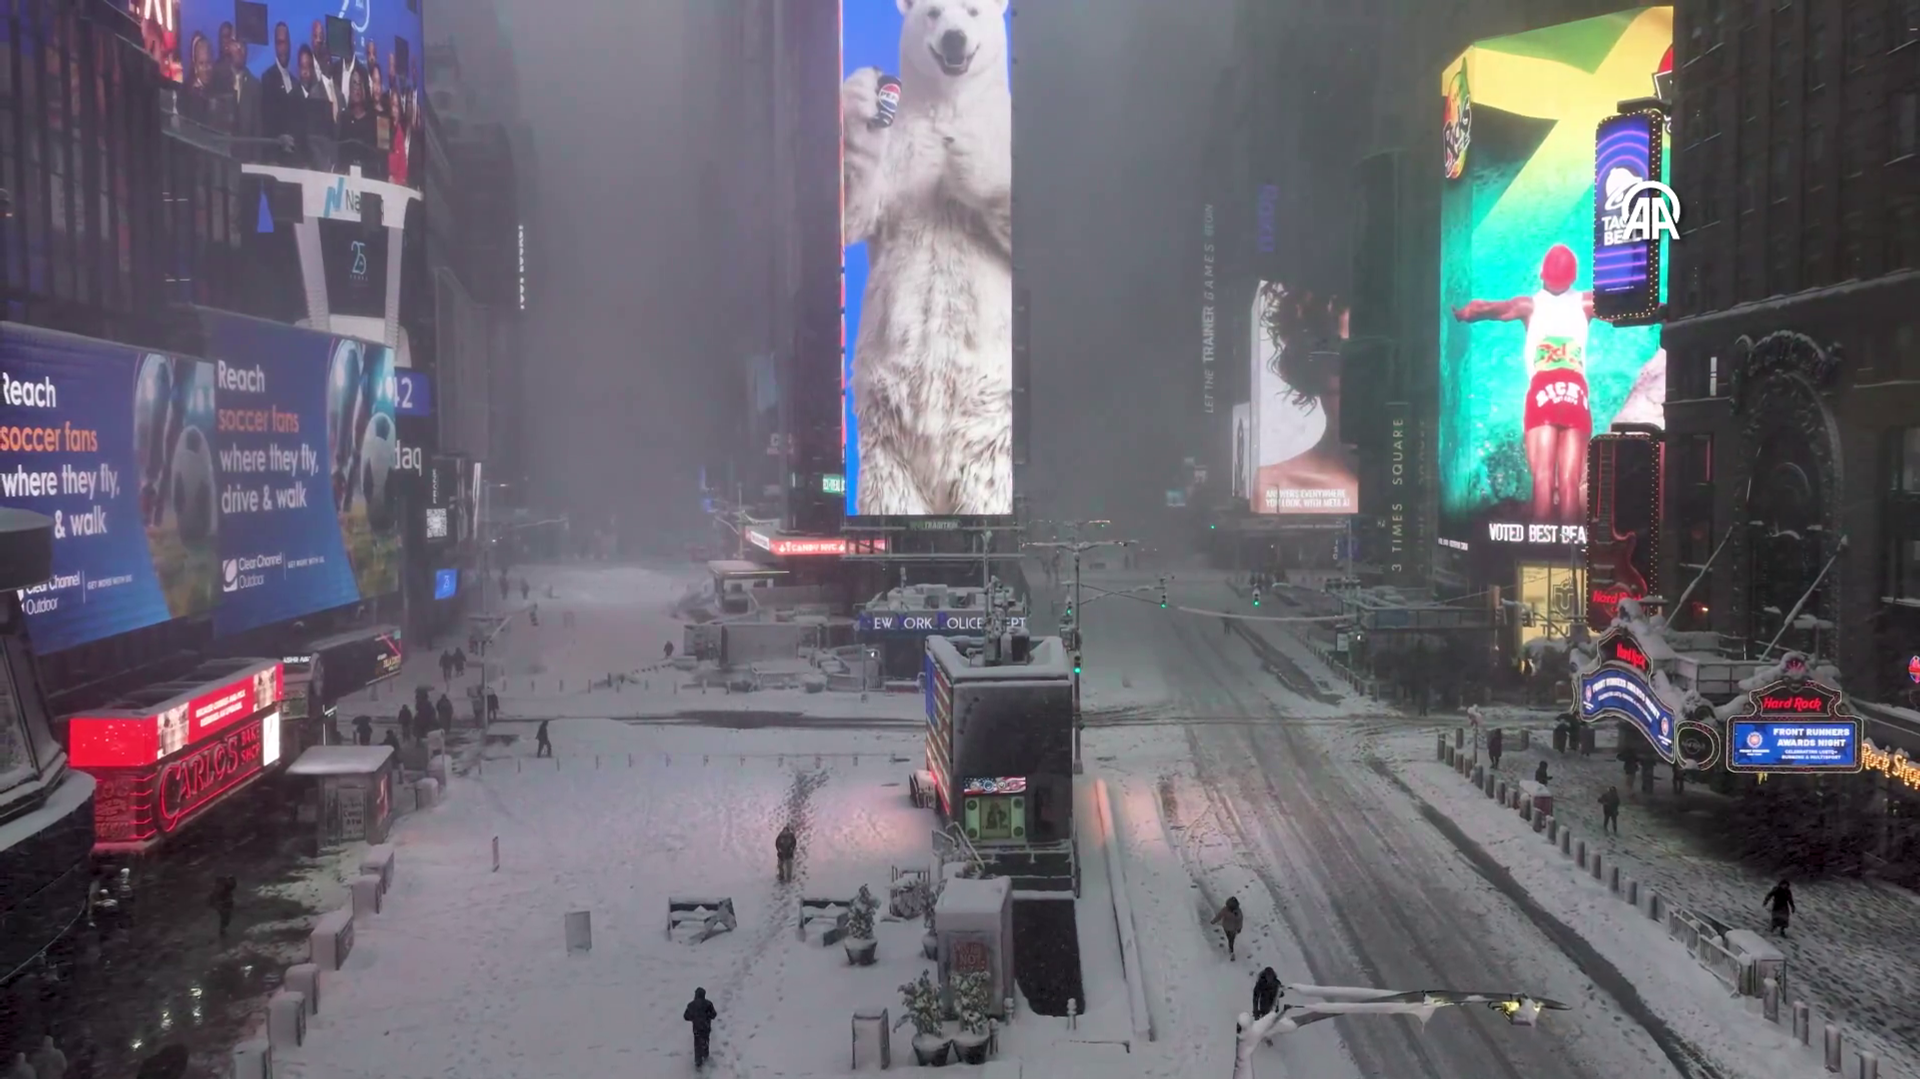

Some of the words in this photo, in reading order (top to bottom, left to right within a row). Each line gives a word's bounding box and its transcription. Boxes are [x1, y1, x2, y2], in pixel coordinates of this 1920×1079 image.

[1604, 230, 1642, 246] BEL
[1204, 244, 1214, 300] GAMES
[1203, 306, 1214, 363] TRAINER
[218, 359, 265, 393] Reach
[1204, 369, 1214, 391] THE
[218, 408, 269, 432] soccer
[272, 404, 299, 433] fans
[1204, 395, 1214, 414] LET
[0, 425, 61, 452] soccer
[65, 421, 98, 452] fans
[220, 442, 266, 472] where
[269, 443, 298, 477] they
[301, 443, 319, 477] fly,
[1392, 419, 1403, 485] SQUARE
[1, 464, 57, 497] where
[62, 464, 96, 500] they
[100, 463, 120, 499] fly,
[221, 484, 259, 514] drive
[263, 484, 272, 511] &
[276, 481, 307, 509] walk
[54, 510, 66, 539] &
[70, 505, 107, 537] walk
[1391, 503, 1403, 553] TIMES
[1489, 523, 1524, 542] VOTED
[1529, 525, 1558, 543] BEST
[791, 543, 818, 552] CANDY
[239, 557, 257, 571] Clear
[1391, 564, 1402, 572] 3
[26, 597, 59, 615] Outdoor
[1763, 697, 1792, 709] Hard
[1794, 697, 1822, 712] Rock
[1773, 728, 1804, 736] FRONT
[1806, 728, 1850, 736] RUNNERS
[1777, 739, 1816, 747] AWARDS
[1818, 739, 1846, 747] NIGHT
[1862, 743, 1891, 778] Rock
